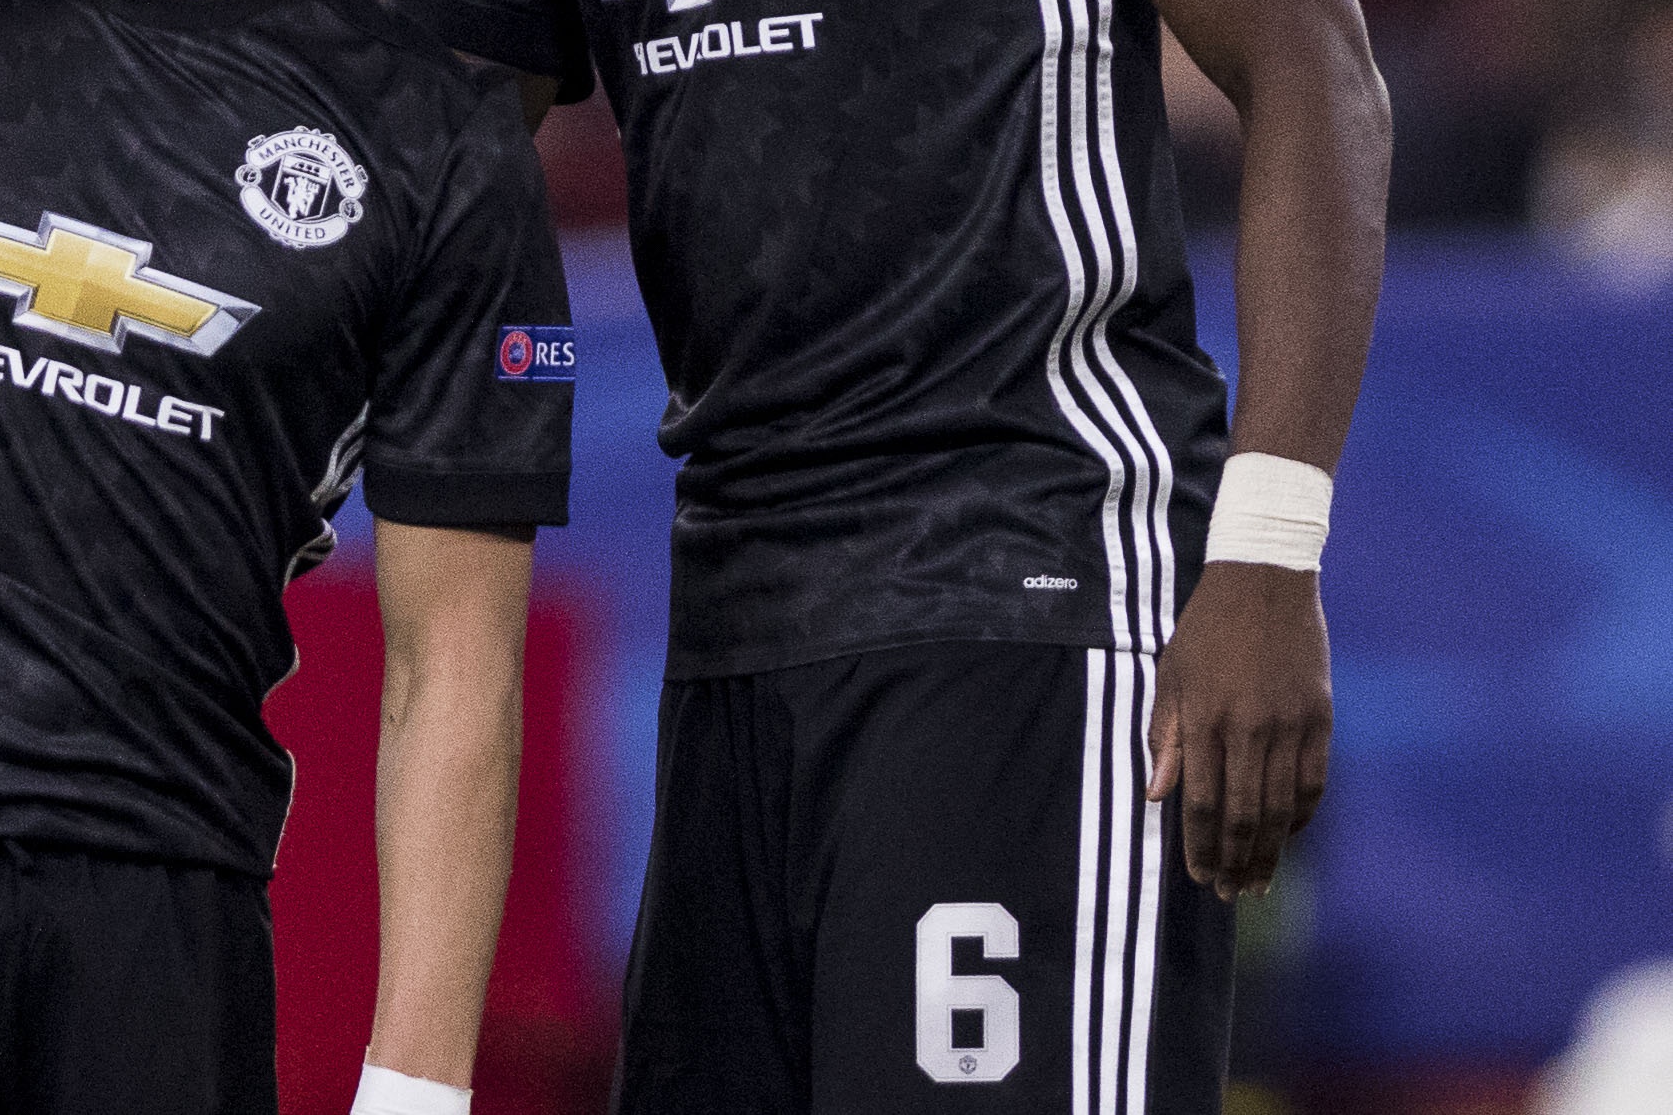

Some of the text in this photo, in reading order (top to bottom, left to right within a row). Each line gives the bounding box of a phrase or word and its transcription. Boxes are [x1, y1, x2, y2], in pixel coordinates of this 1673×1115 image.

[258, 136, 355, 189] MANCHESTER
[259, 207, 326, 240] UNITED
[1023, 574, 1078, 590] adizero
[916, 902, 1020, 1082] 6
